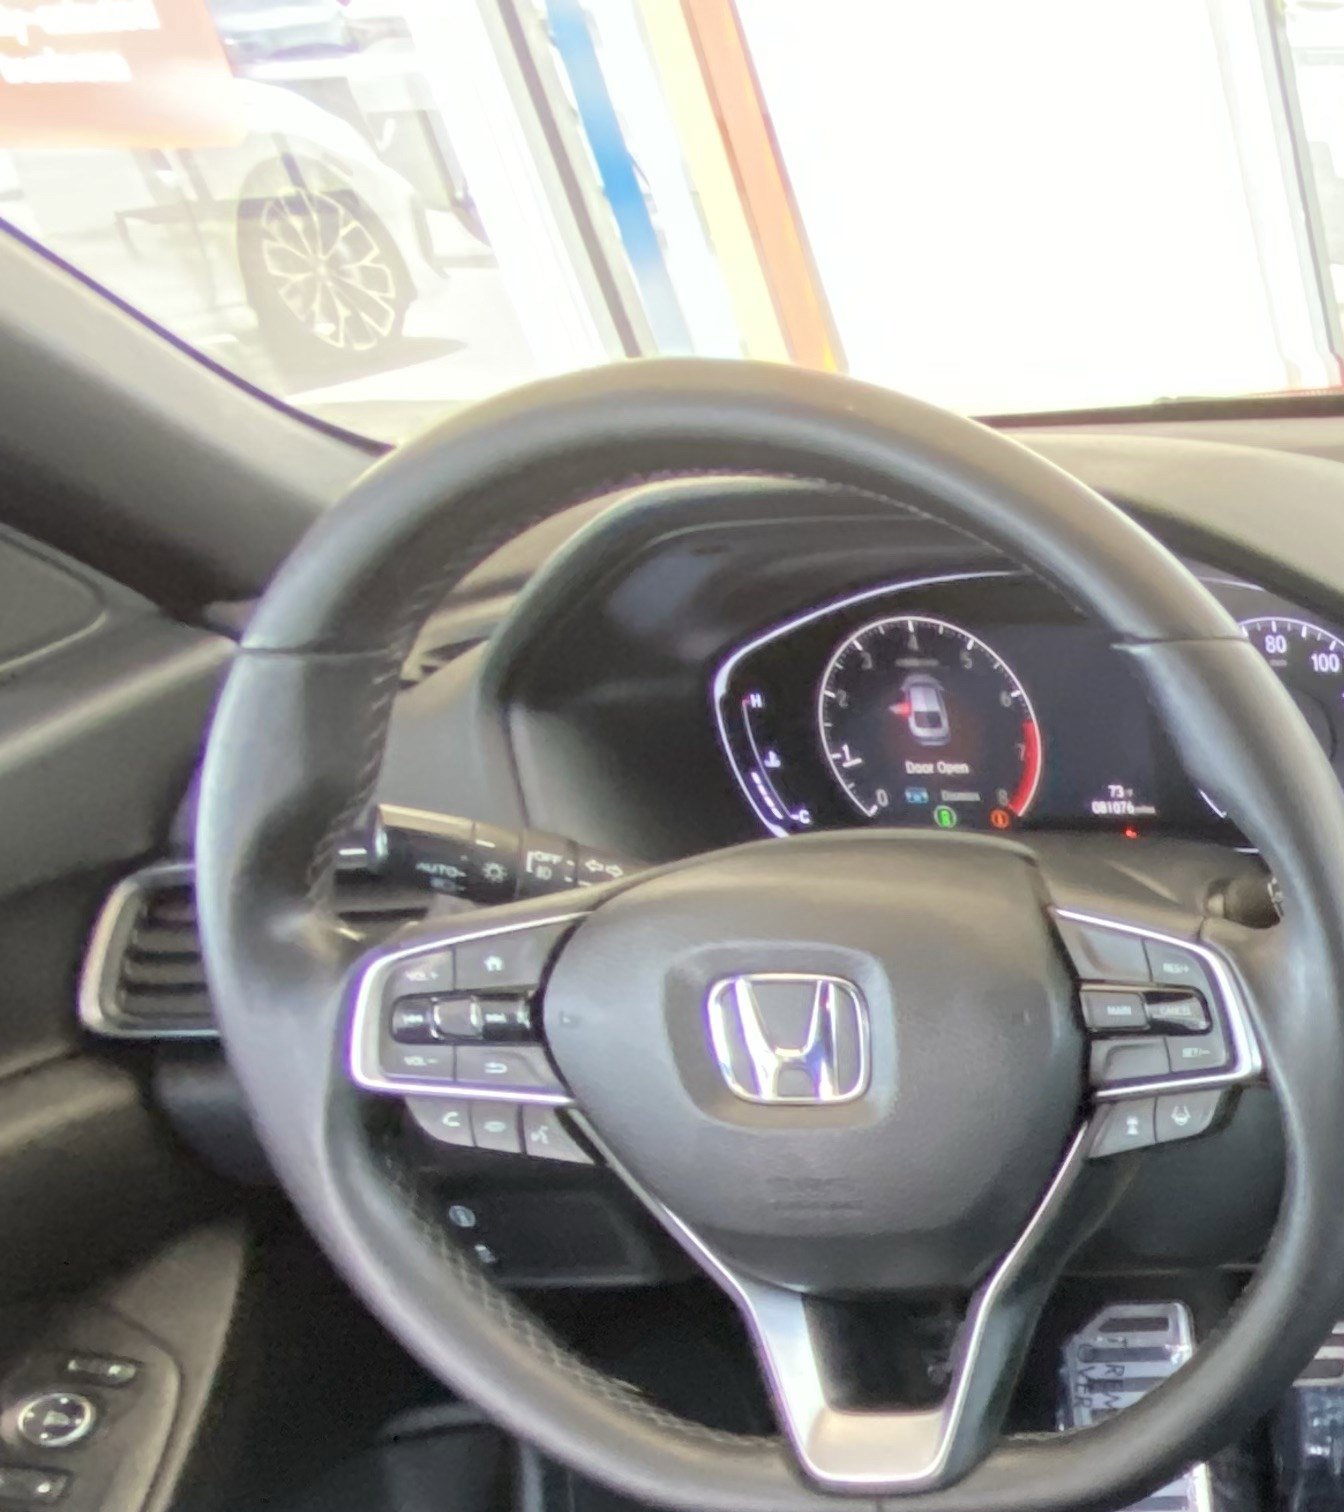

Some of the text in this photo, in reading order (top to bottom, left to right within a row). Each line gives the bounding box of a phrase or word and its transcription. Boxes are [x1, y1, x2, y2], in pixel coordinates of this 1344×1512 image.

[1265, 635, 1287, 653] 80
[1311, 653, 1340, 672] 100
[905, 761, 970, 775] Door Open
